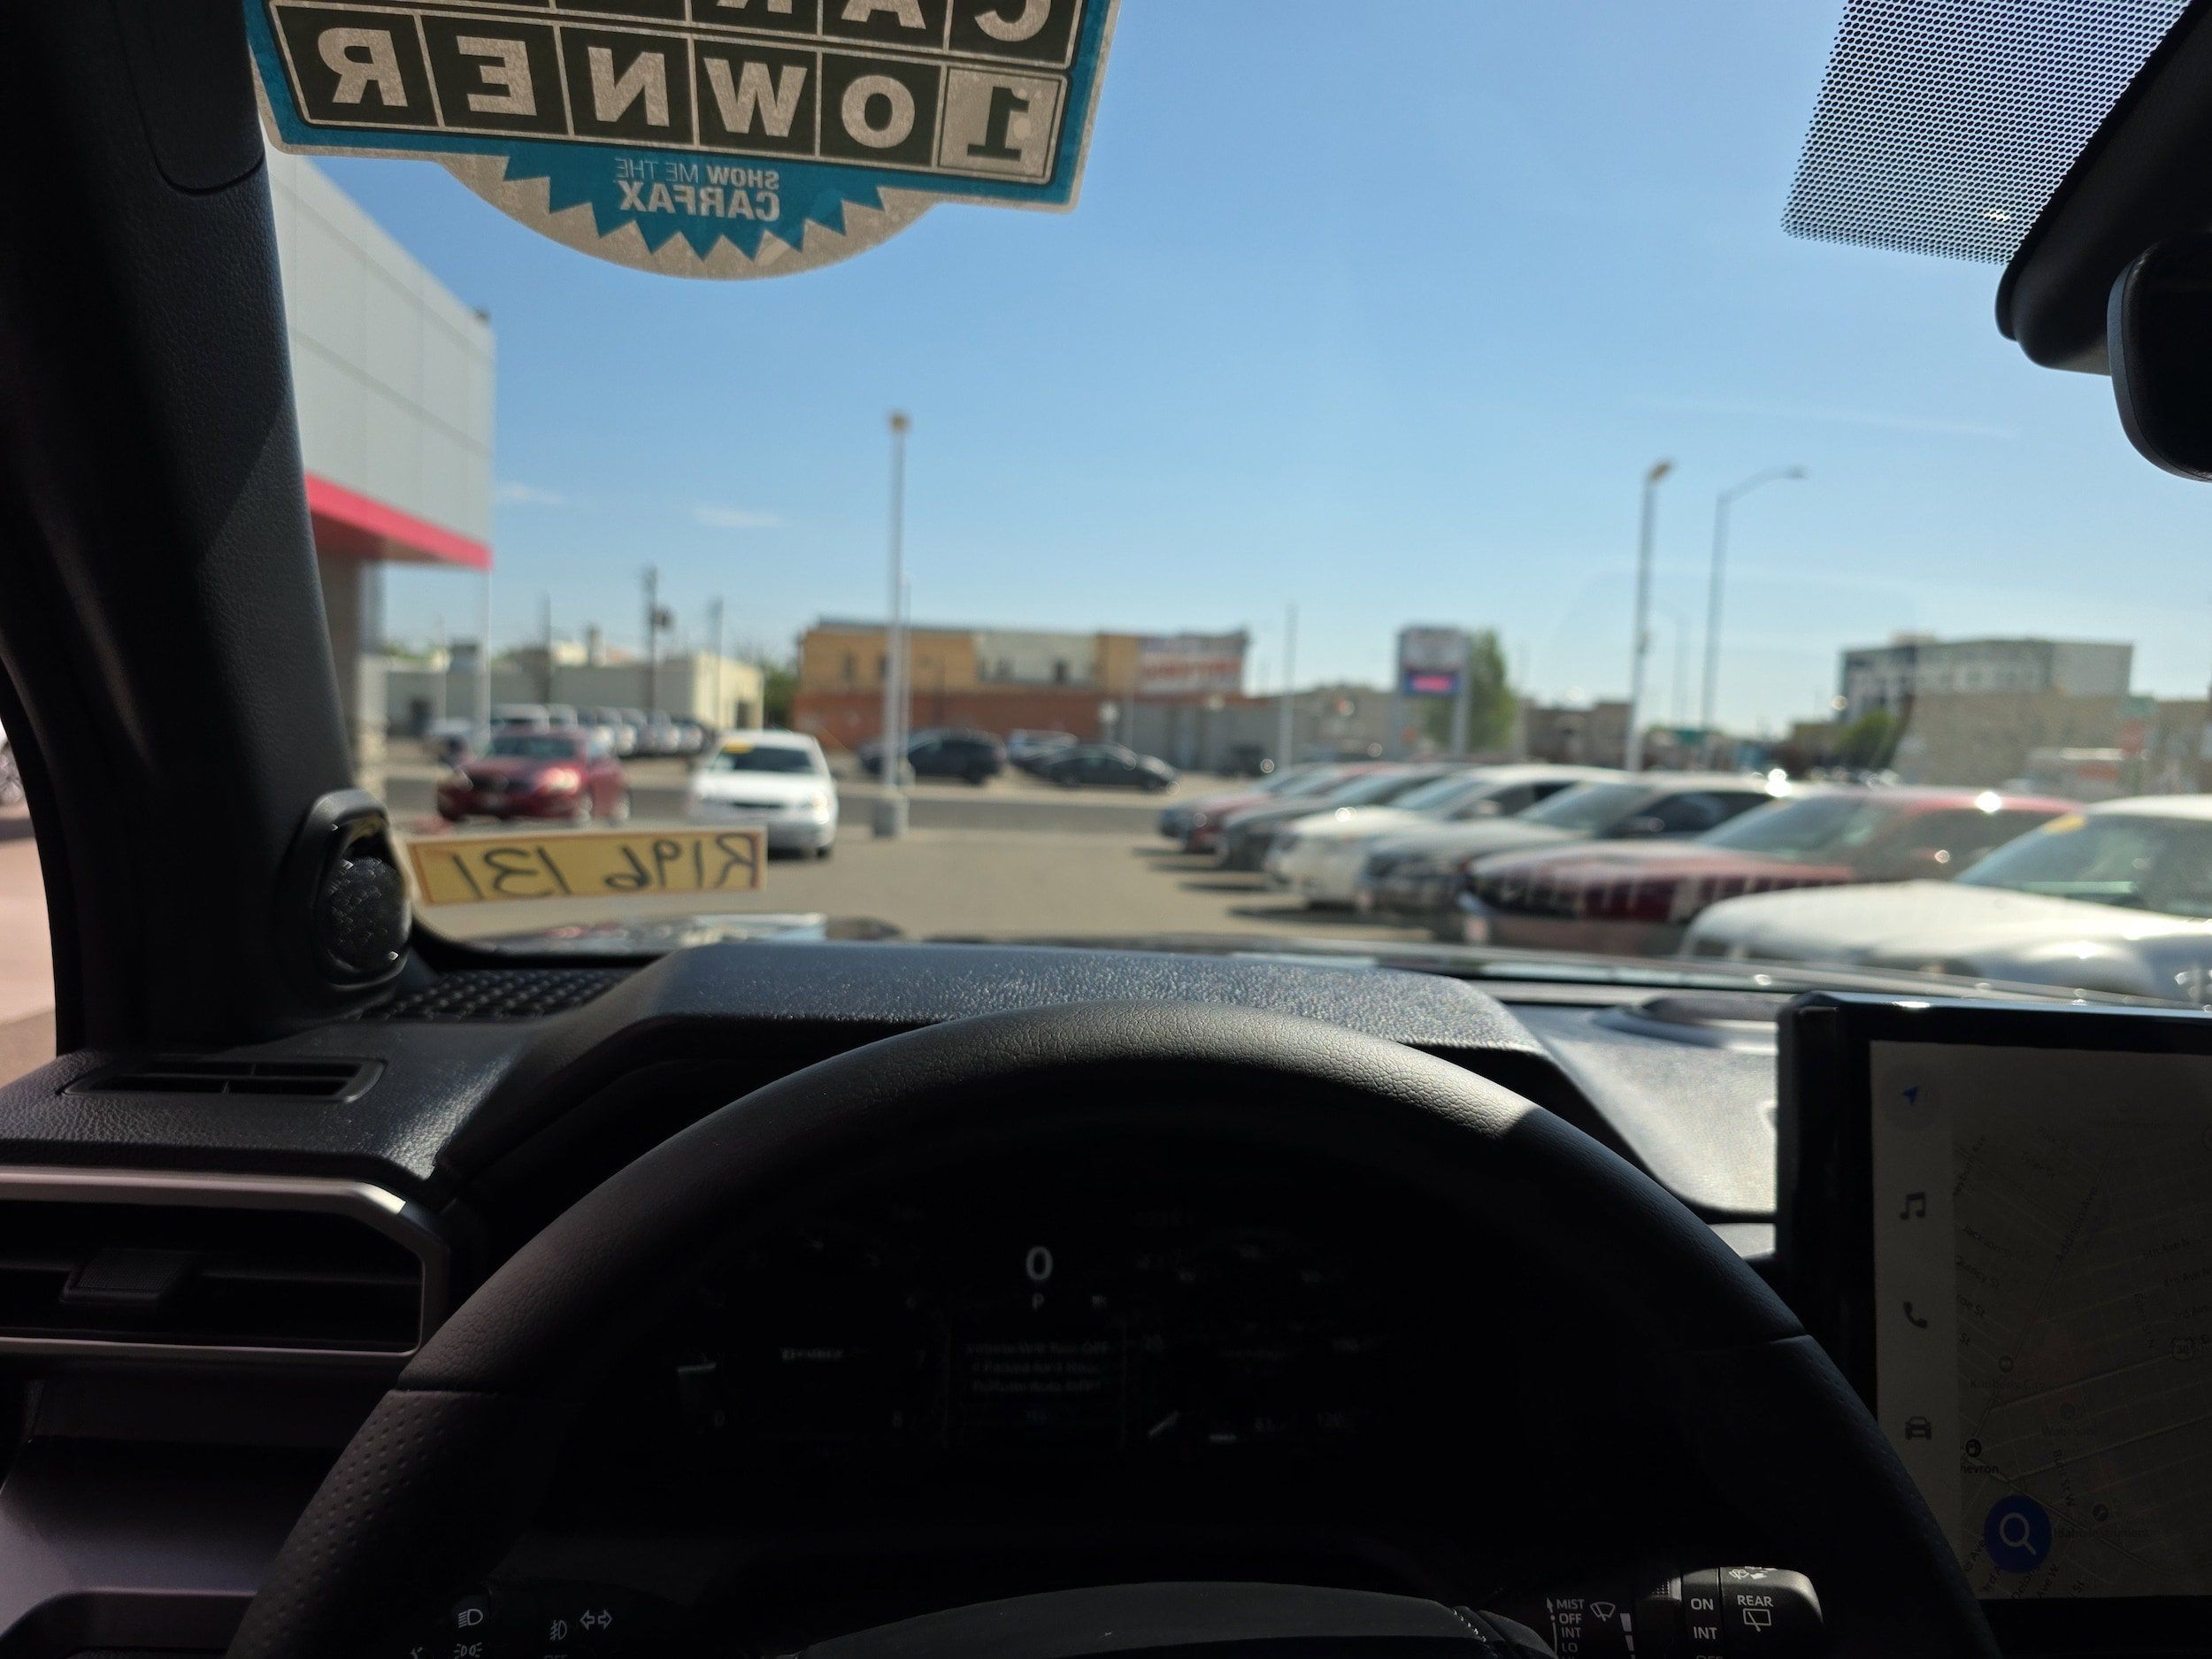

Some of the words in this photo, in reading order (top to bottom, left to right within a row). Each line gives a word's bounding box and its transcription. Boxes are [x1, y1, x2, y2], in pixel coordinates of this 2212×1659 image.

[1025, 1246, 1053, 1280] 0
[1031, 1292, 1045, 1311] P
[1960, 1464, 2000, 1475] hevron
[1556, 1598, 1585, 1609] MIST
[1690, 1597, 1715, 1610] ON
[1737, 1594, 1774, 1607] REAR
[1559, 1612, 1582, 1624] OFF
[1561, 1626, 1582, 1639] INT
[1693, 1625, 1717, 1640] INT
